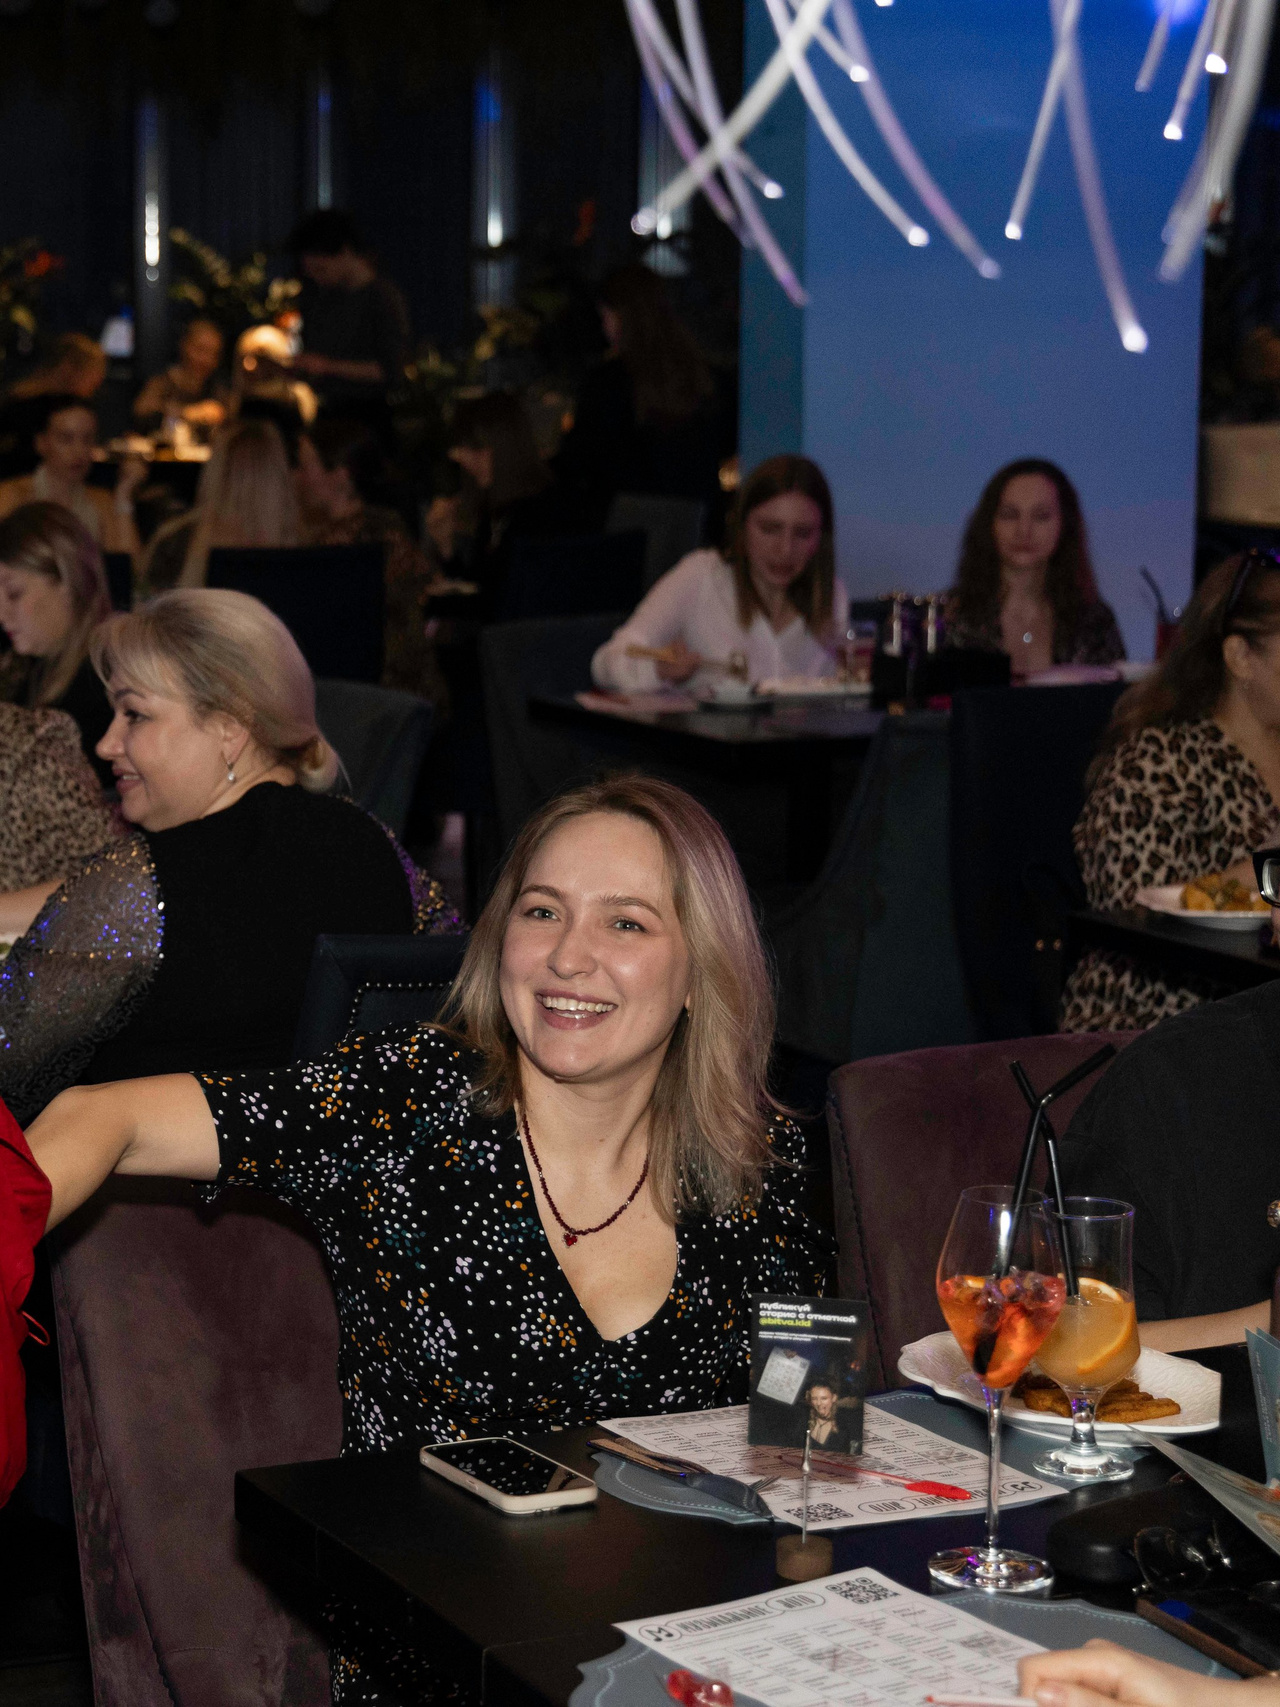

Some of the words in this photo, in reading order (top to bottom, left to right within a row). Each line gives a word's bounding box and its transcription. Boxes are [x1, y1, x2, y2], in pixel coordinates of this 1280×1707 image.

[759, 1302, 811, 1311] публикуй
[759, 1310, 797, 1319] сторис
[806, 1313, 857, 1323] отметкой
[677, 1605, 771, 1633] МУЗЫКАЛЬНОЕ
[776, 1594, 816, 1609] ЛОТО
